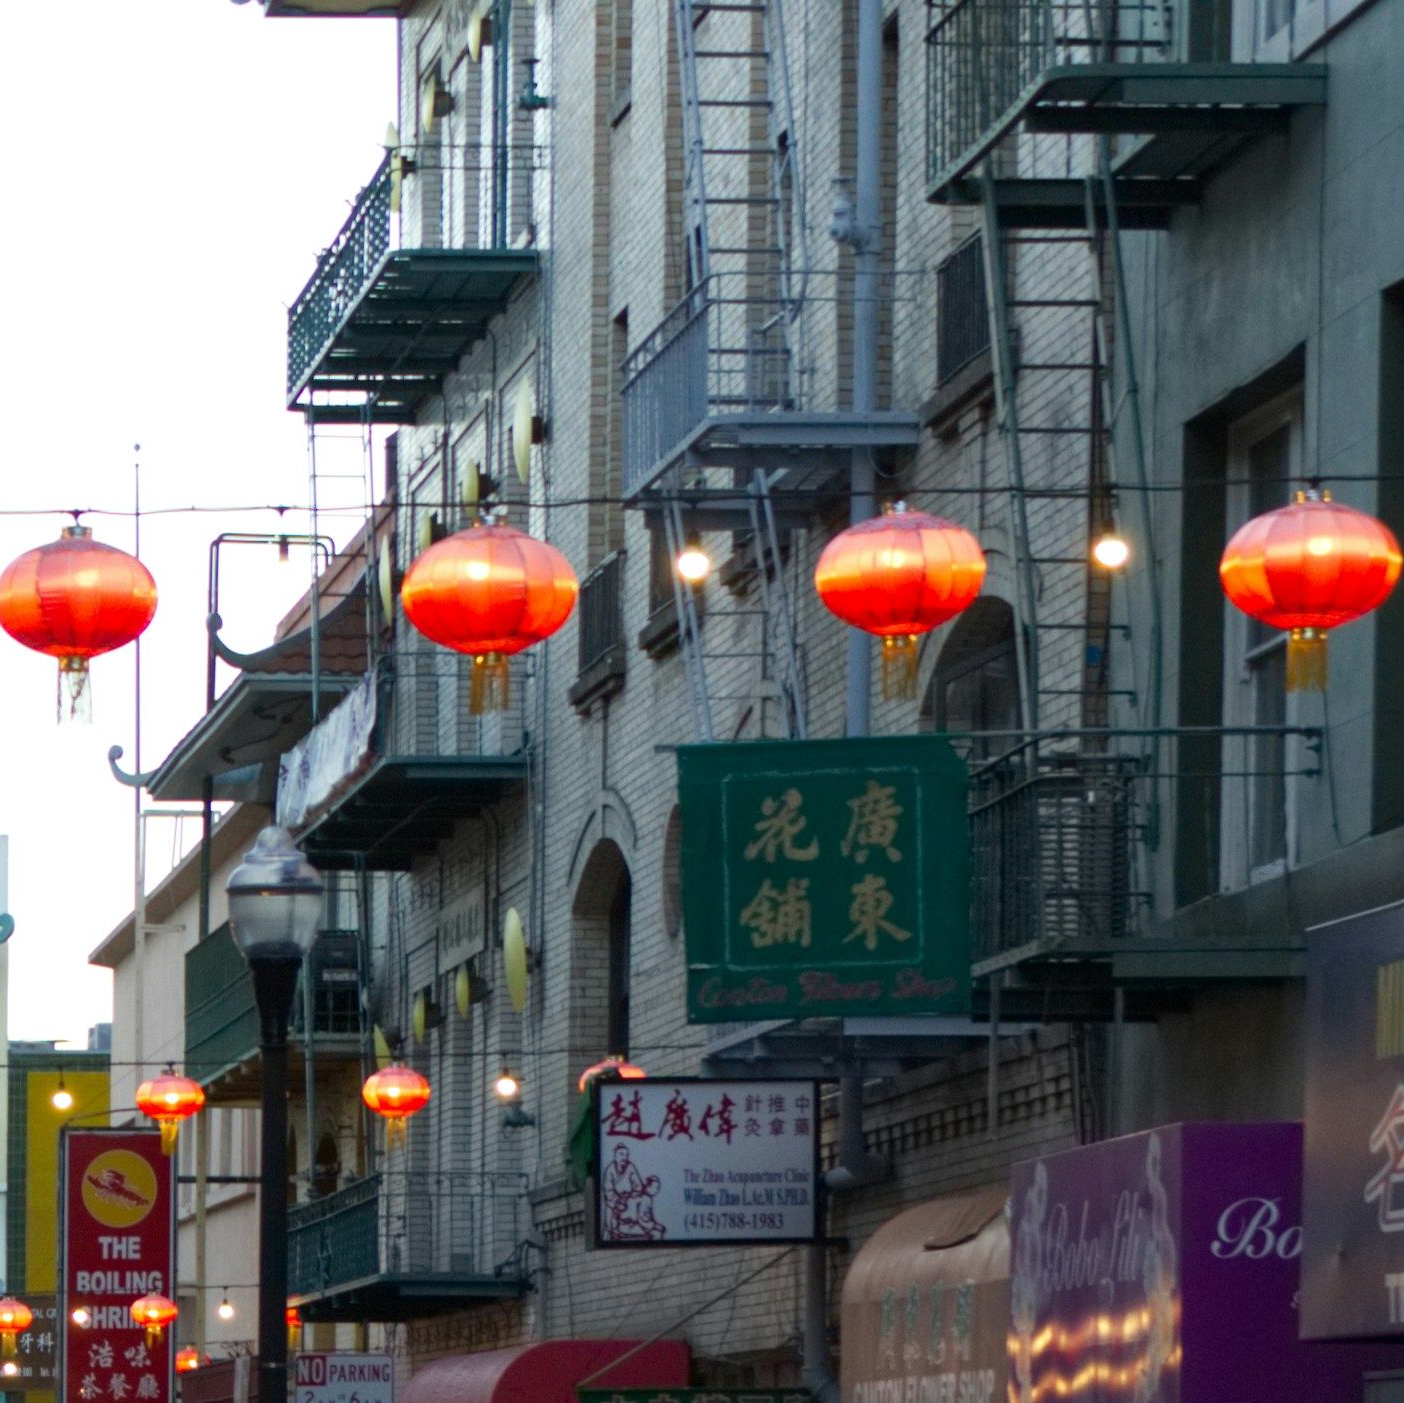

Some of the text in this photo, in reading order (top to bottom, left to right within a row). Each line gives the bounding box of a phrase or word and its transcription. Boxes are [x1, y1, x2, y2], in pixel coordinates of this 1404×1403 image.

[684, 1213, 784, 1232] (415)788-1983
[98, 1236, 141, 1260] THE
[76, 1271, 163, 1296] BOILING
[297, 1357, 390, 1385] NO PARKING
